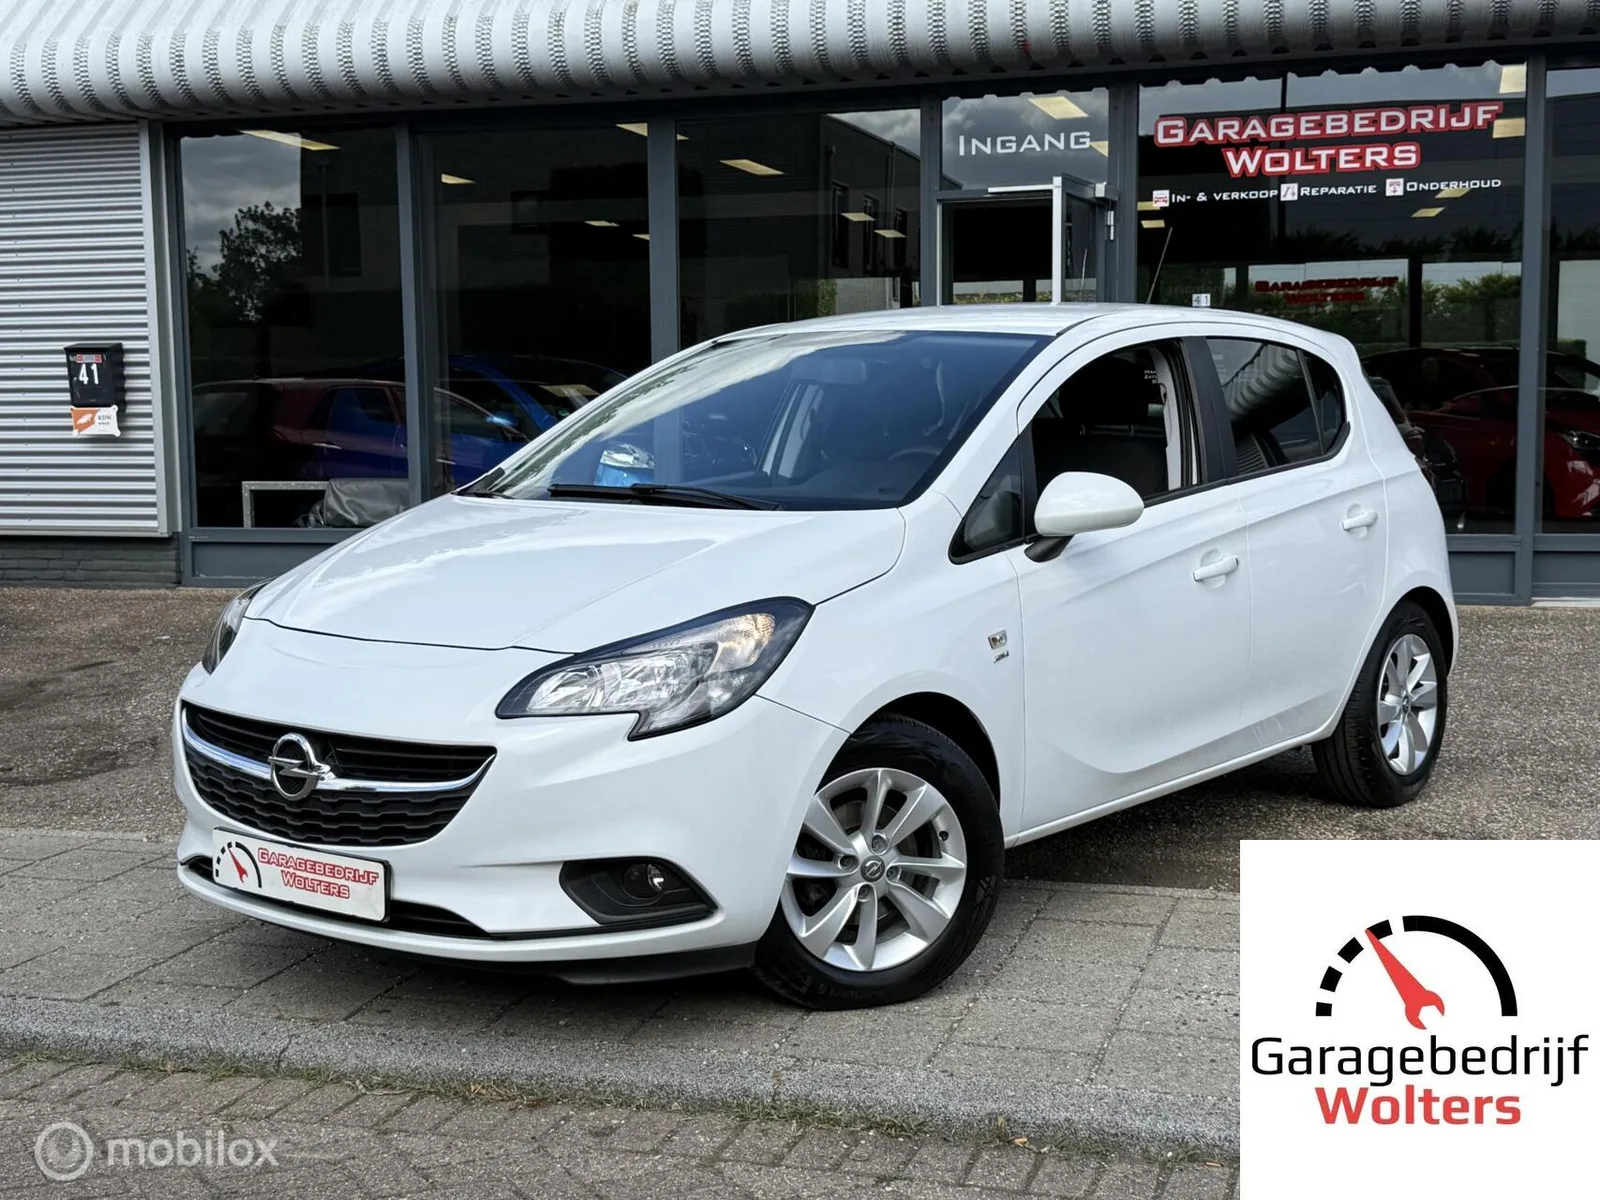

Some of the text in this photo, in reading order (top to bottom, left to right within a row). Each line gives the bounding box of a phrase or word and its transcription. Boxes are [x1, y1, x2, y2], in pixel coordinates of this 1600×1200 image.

[1154, 101, 1503, 147] GARAGEBEDRIJF
[959, 131, 1091, 156] INGANG
[1221, 142, 1421, 178] WOLTERS
[1196, 192, 1208, 202] &
[1213, 189, 1278, 201] VERKOOP
[1300, 184, 1377, 197] REPARATIE
[1406, 179, 1502, 192] ONDERHOUD
[1193, 294, 1209, 306] 41
[79, 363, 99, 385] 41
[257, 847, 379, 886] GARAGEBEDRIJF
[281, 869, 351, 900] WOLTERS
